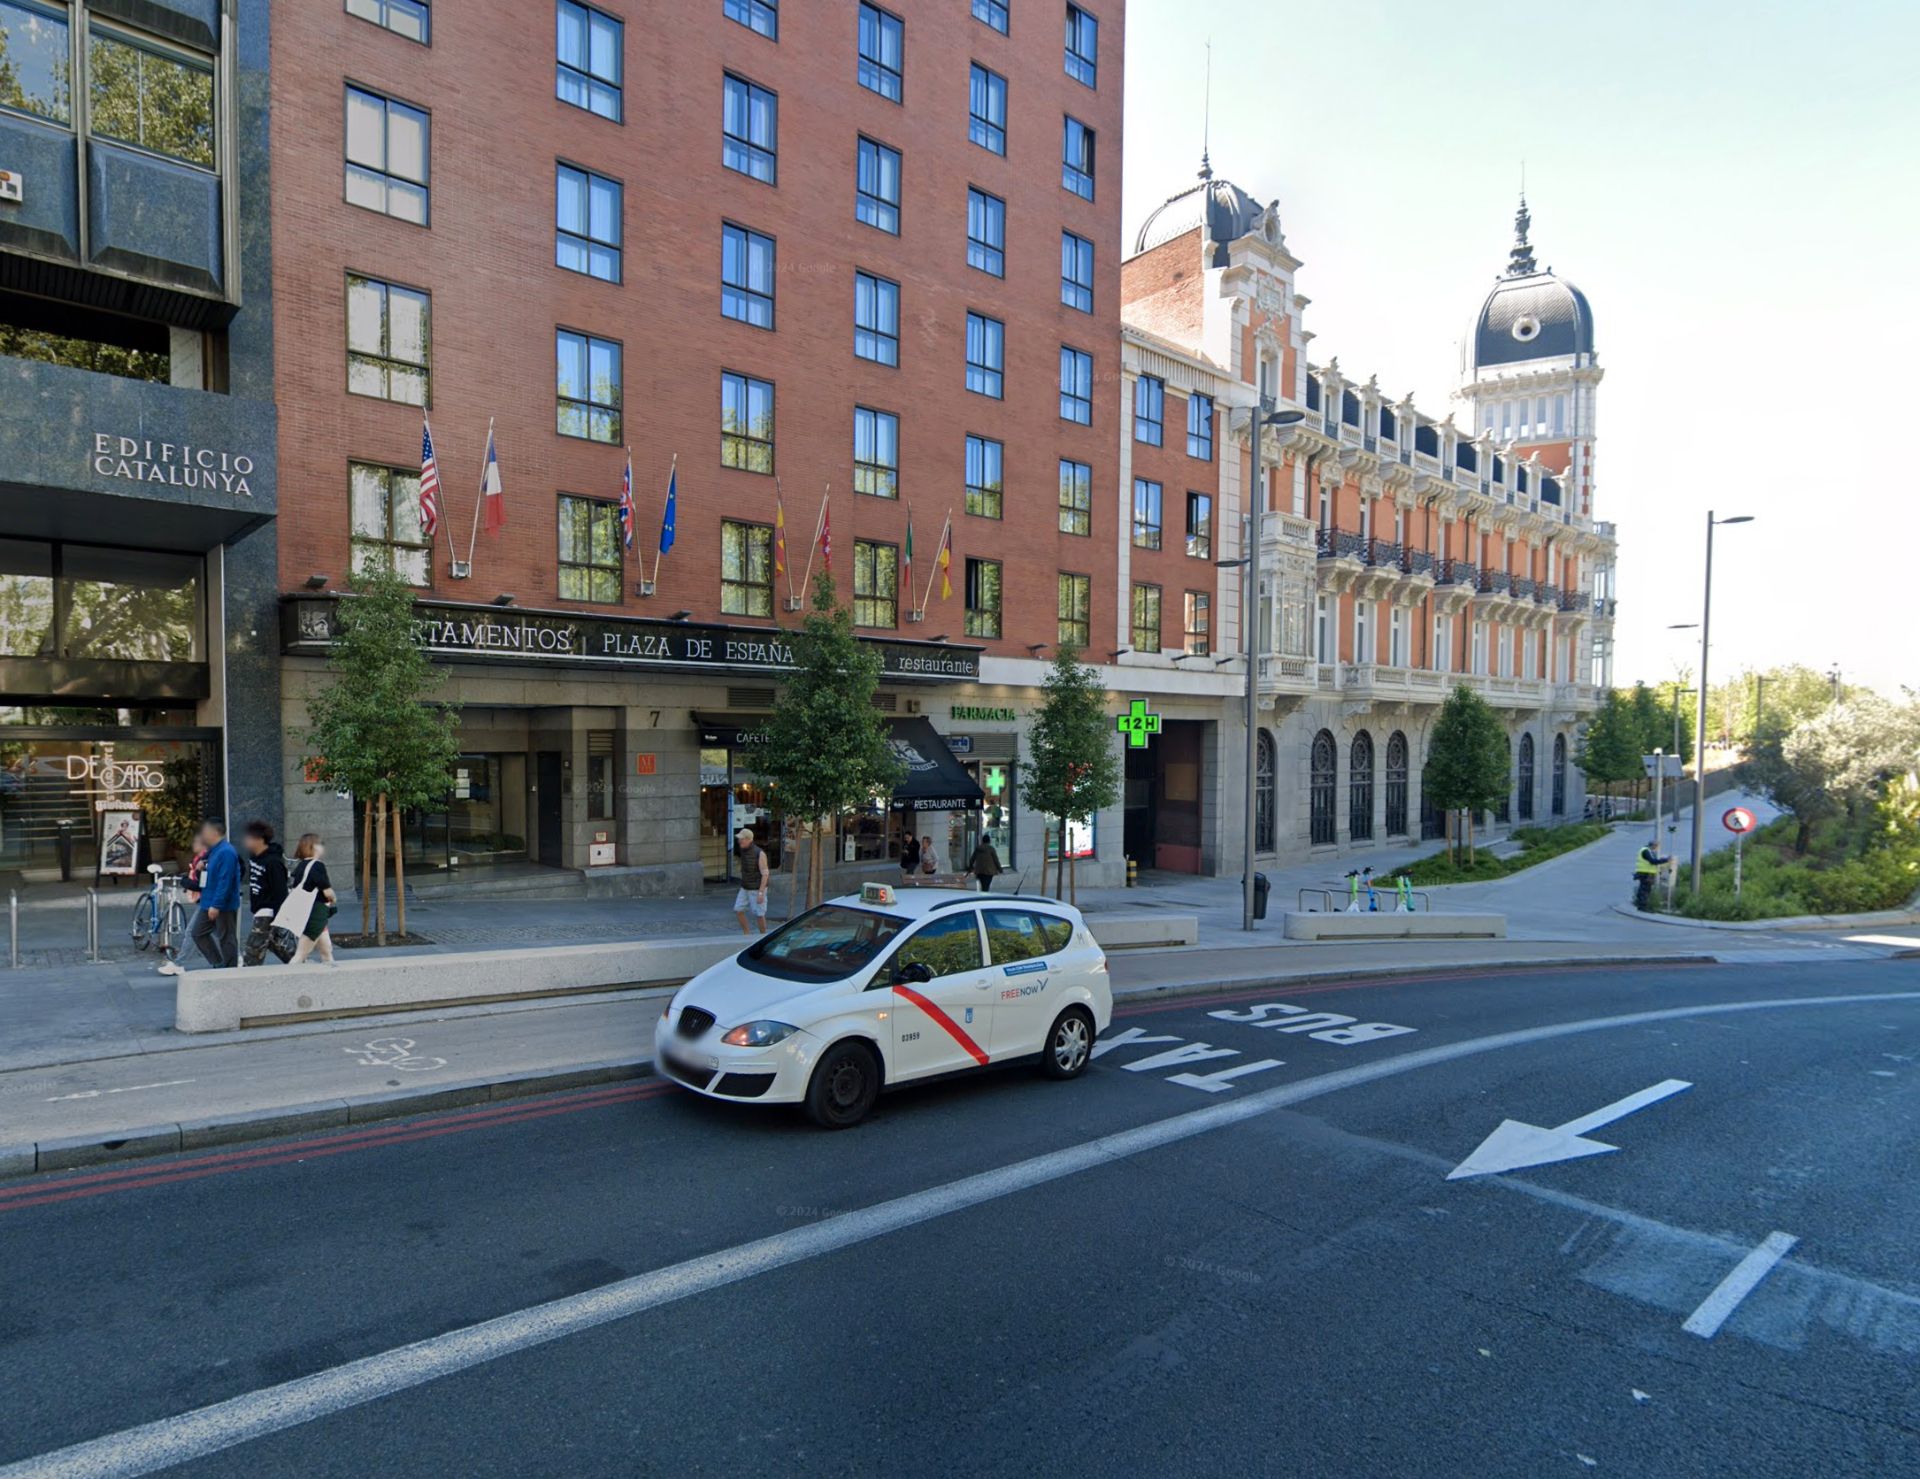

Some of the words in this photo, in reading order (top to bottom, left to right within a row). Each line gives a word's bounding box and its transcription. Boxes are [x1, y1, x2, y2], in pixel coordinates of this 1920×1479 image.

[95, 432, 254, 475] EDIFICIO
[94, 456, 252, 496] CATALUNYA
[355, 613, 572, 650] RTAMENTOS
[603, 633, 672, 657] PLAZA
[686, 638, 713, 659] DE
[726, 640, 795, 663] ESPAÑA
[899, 656, 974, 674] restaurante
[650, 710, 661, 728] 7
[951, 705, 1016, 720] FARMACIA
[1123, 717, 1155, 730] 12H
[736, 732, 774, 744] CAFETE
[66, 754, 101, 780] DE
[913, 798, 967, 810] RESTAURANTE
[1001, 984, 1039, 1001] FREENOW
[1207, 1003, 1419, 1046] BUS
[1088, 1026, 1288, 1094] TAX
